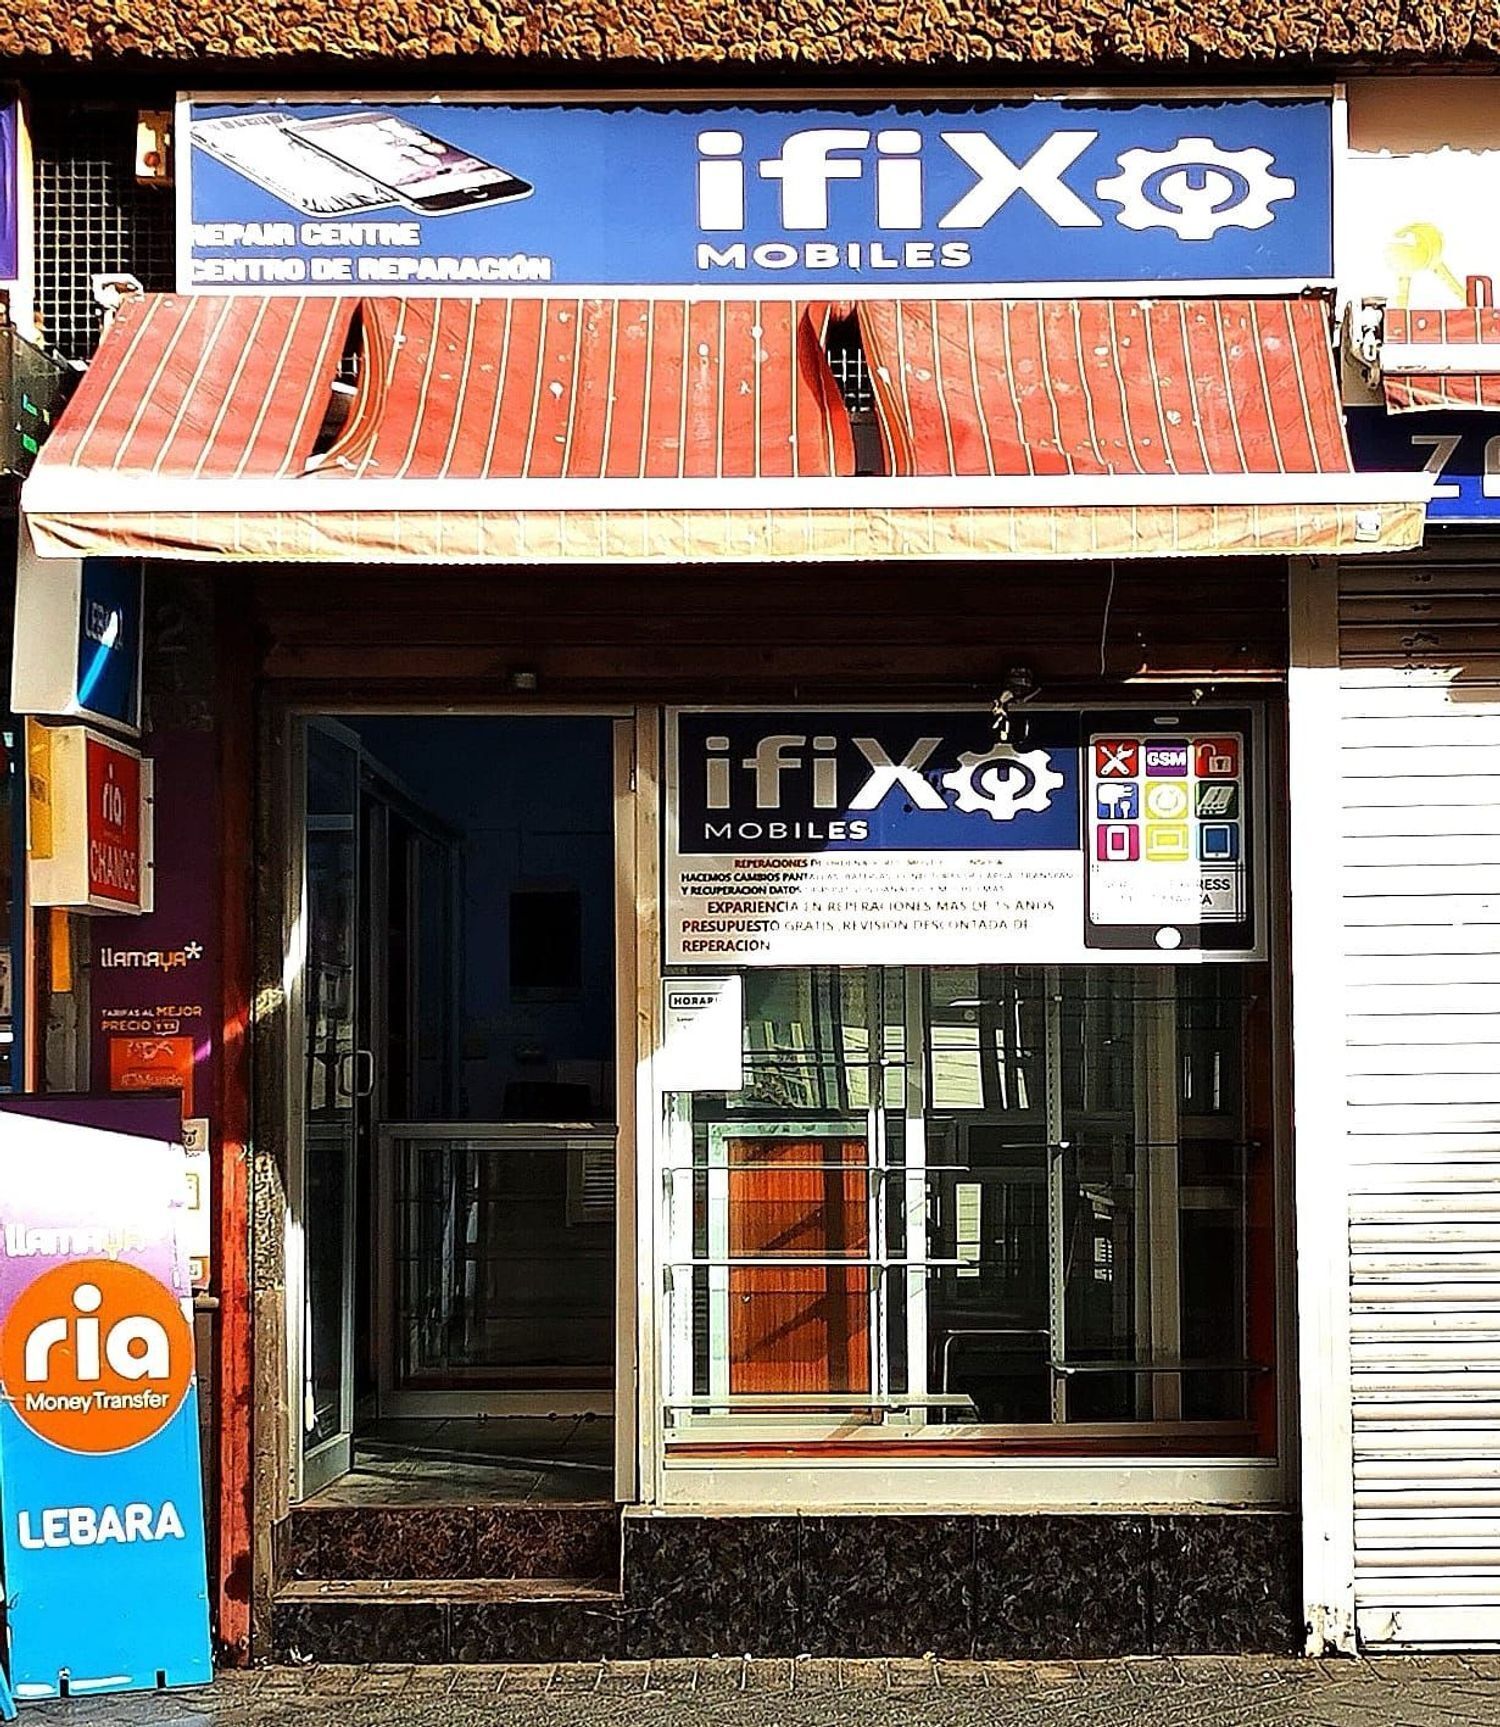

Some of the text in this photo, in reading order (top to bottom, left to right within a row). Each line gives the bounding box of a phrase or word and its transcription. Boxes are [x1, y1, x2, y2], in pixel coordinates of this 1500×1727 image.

[192, 222, 421, 247] REPAIR CENTRE
[696, 242, 972, 271] MOBILES
[192, 253, 551, 282] CENTRO DE REPARACIÓN
[1146, 751, 1188, 767] GSM
[704, 821, 868, 840] MOBILES
[89, 839, 137, 892] CHANGE
[681, 873, 732, 882] HACEMOS
[733, 873, 781, 882] CAMBIOS
[681, 886, 688, 895] Y
[690, 886, 767, 895] RECUPERACION
[682, 920, 780, 932] PRESUPUESTO
[682, 940, 770, 952] REPERACION
[155, 1005, 203, 1017] MEJOR
[101, 1020, 152, 1031] PRECIO
[25, 1284, 170, 1382] ria
[25, 1390, 170, 1414] Money Transfer
[17, 1501, 186, 1550] LEBARA
